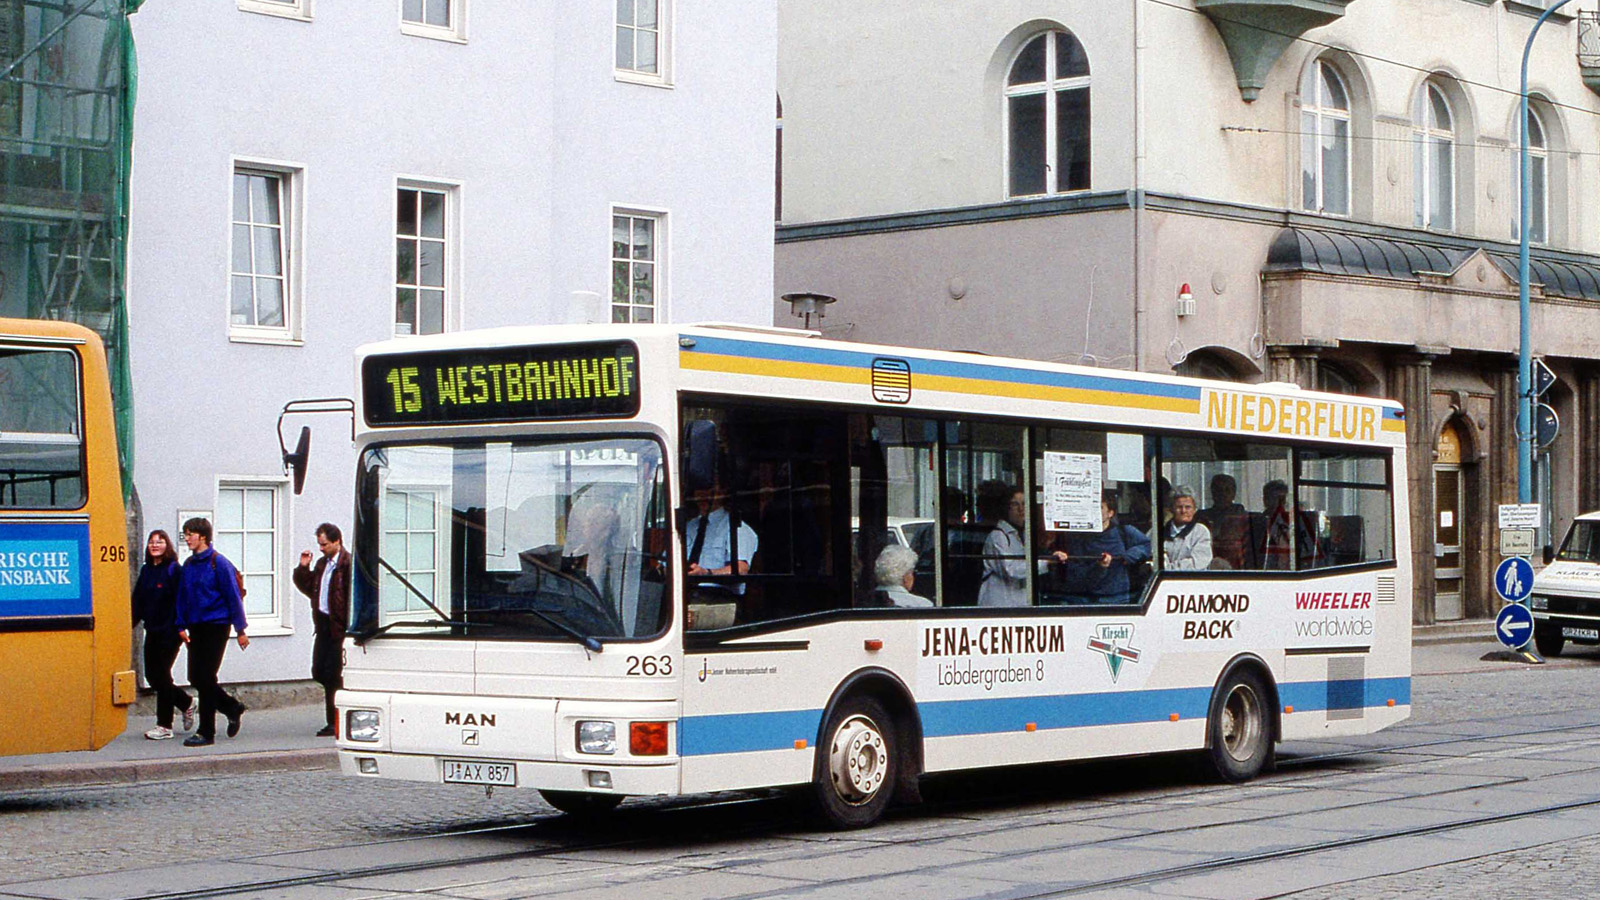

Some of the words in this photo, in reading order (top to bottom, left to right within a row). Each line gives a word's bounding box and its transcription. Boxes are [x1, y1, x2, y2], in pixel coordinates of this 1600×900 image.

[386, 367, 422, 413] 15
[436, 356, 634, 404] WESTBAHNHOF
[1207, 391, 1376, 441] NIEDERFLUR
[100, 546, 125, 562] 296
[1166, 594, 1250, 614] DIAMOND
[1295, 592, 1372, 610] WHEELER
[1183, 619, 1234, 640] BACK
[1295, 616, 1373, 638] worldwide
[922, 625, 1065, 658] JENA-CENTRUM
[626, 655, 673, 676] 263
[938, 658, 1032, 691] Löbdergraben
[1036, 660, 1045, 682] 8
[445, 712, 496, 727] MAN
[488, 765, 509, 781] 857
